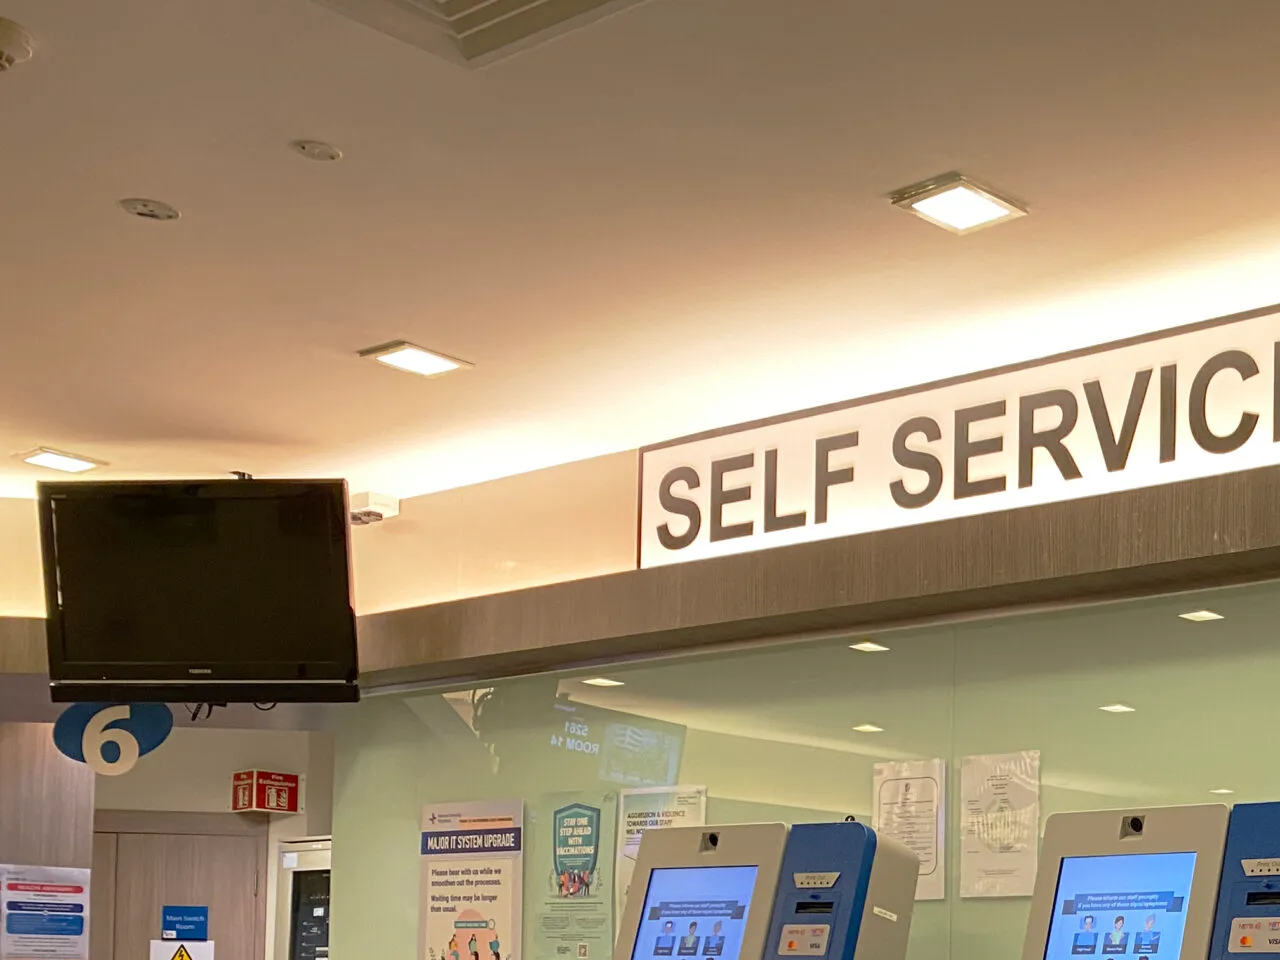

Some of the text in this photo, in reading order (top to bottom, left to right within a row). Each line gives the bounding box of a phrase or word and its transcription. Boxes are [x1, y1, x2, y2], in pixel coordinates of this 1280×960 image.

[656, 431, 859, 550] SELF
[82, 704, 140, 776] 6
[427, 833, 515, 850] MAJOR IT SYSTEM UPGRADE
